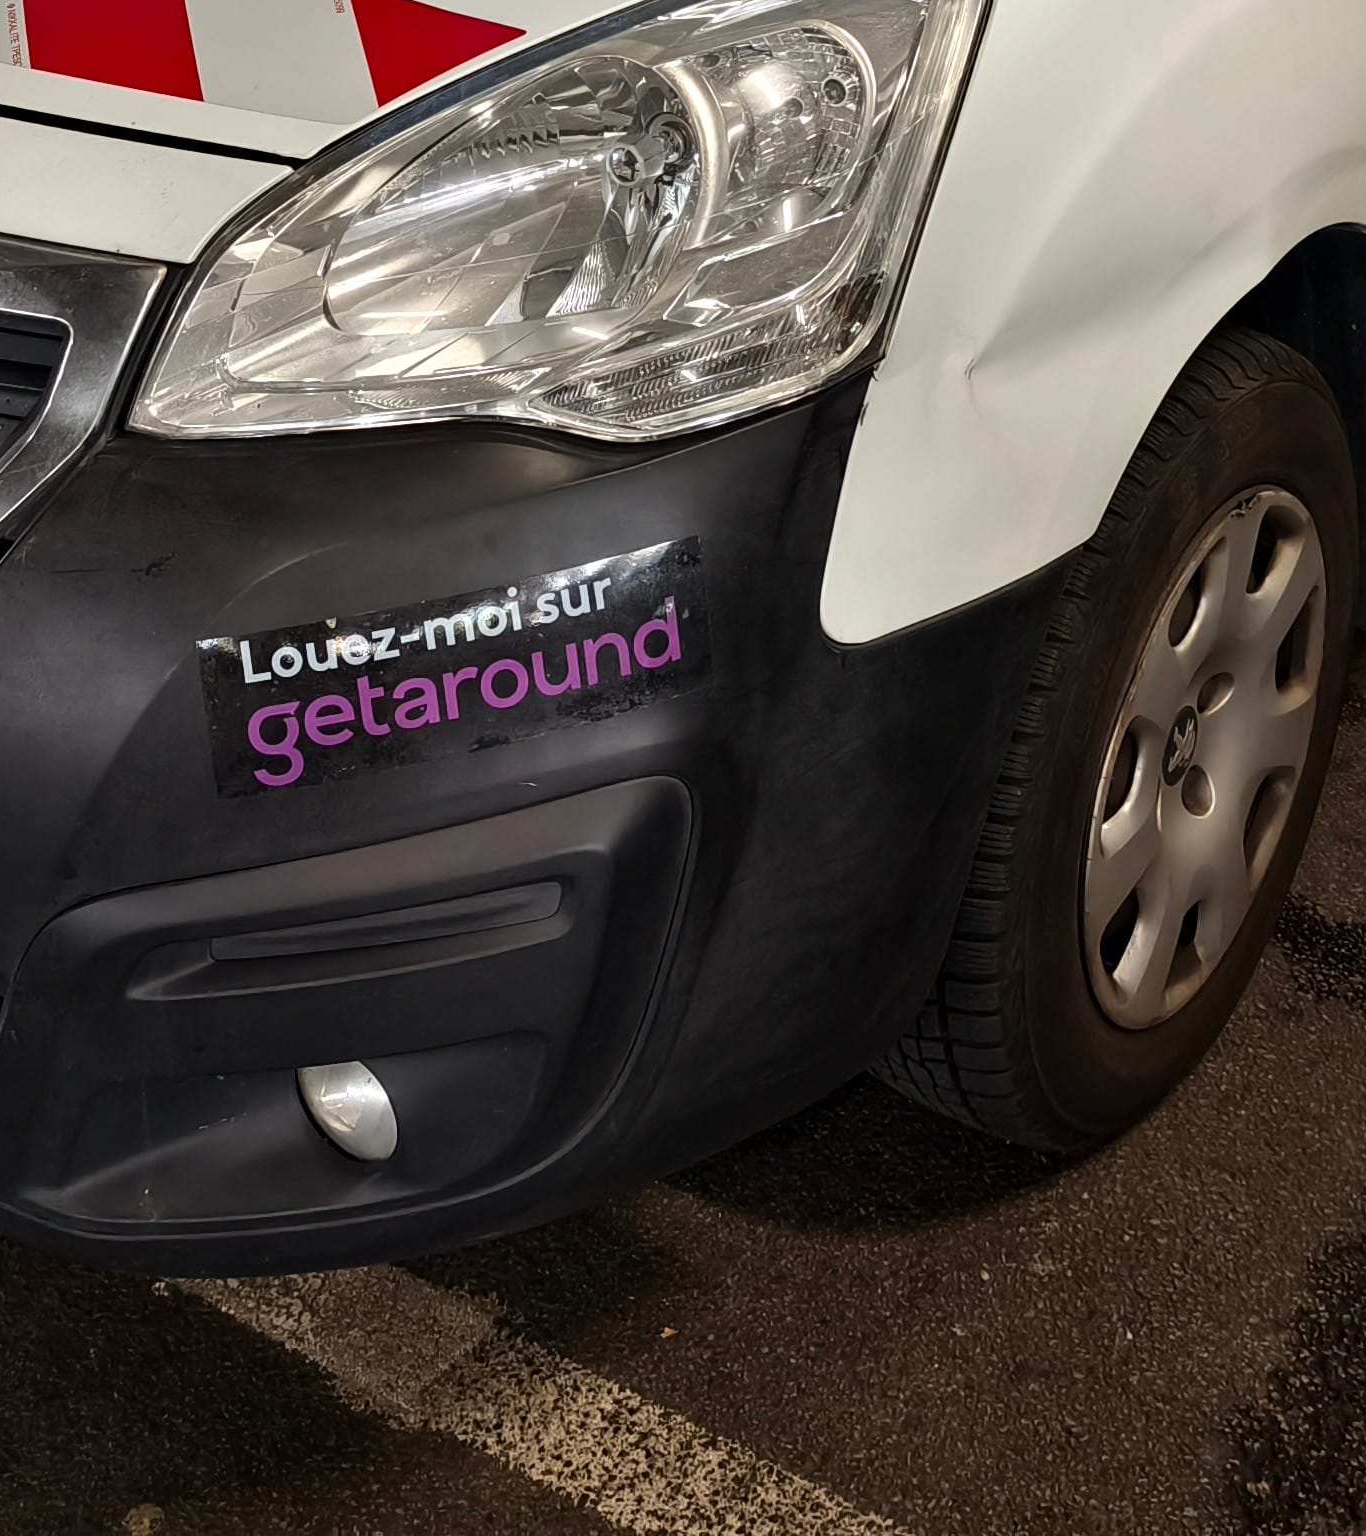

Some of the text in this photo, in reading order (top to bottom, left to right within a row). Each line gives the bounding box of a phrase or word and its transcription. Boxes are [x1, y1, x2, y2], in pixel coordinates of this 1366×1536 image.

[238, 575, 614, 685] Louez-moi sur
[246, 594, 683, 787] getaround
